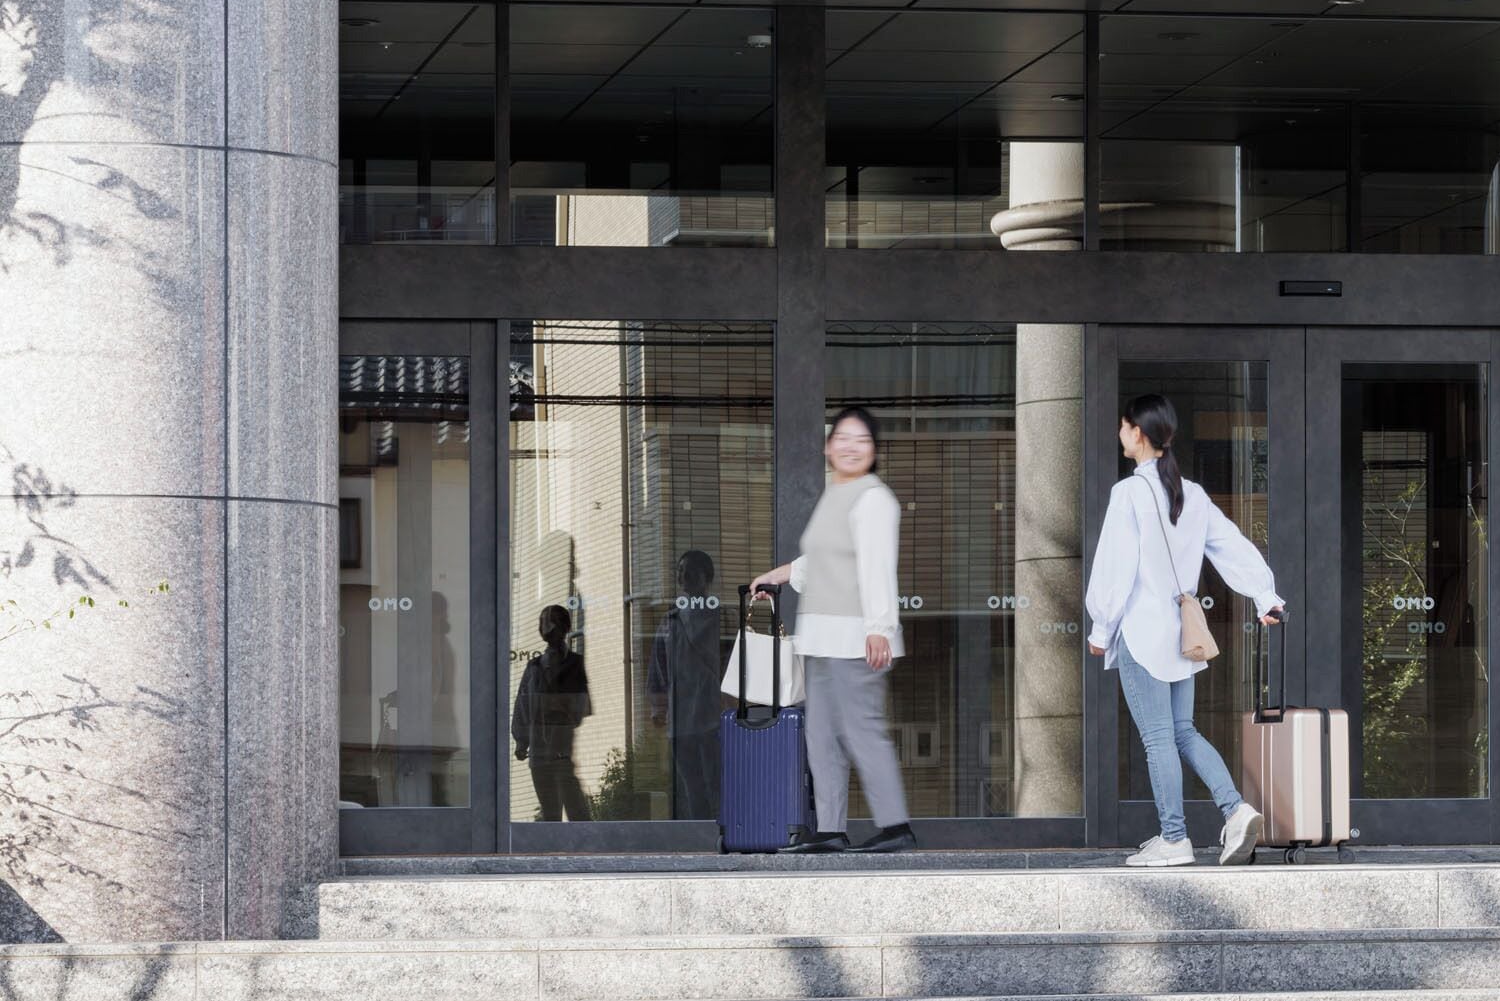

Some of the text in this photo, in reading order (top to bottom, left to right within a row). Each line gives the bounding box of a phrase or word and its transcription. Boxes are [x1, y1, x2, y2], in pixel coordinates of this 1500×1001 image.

[369, 597, 413, 611] OMO
[676, 596, 720, 610] OMO
[898, 596, 924, 609] MO
[988, 596, 1030, 609] OMO
[1393, 596, 1435, 610] OMO
[1040, 622, 1079, 634] OMO
[1408, 622, 1446, 634] OMO
